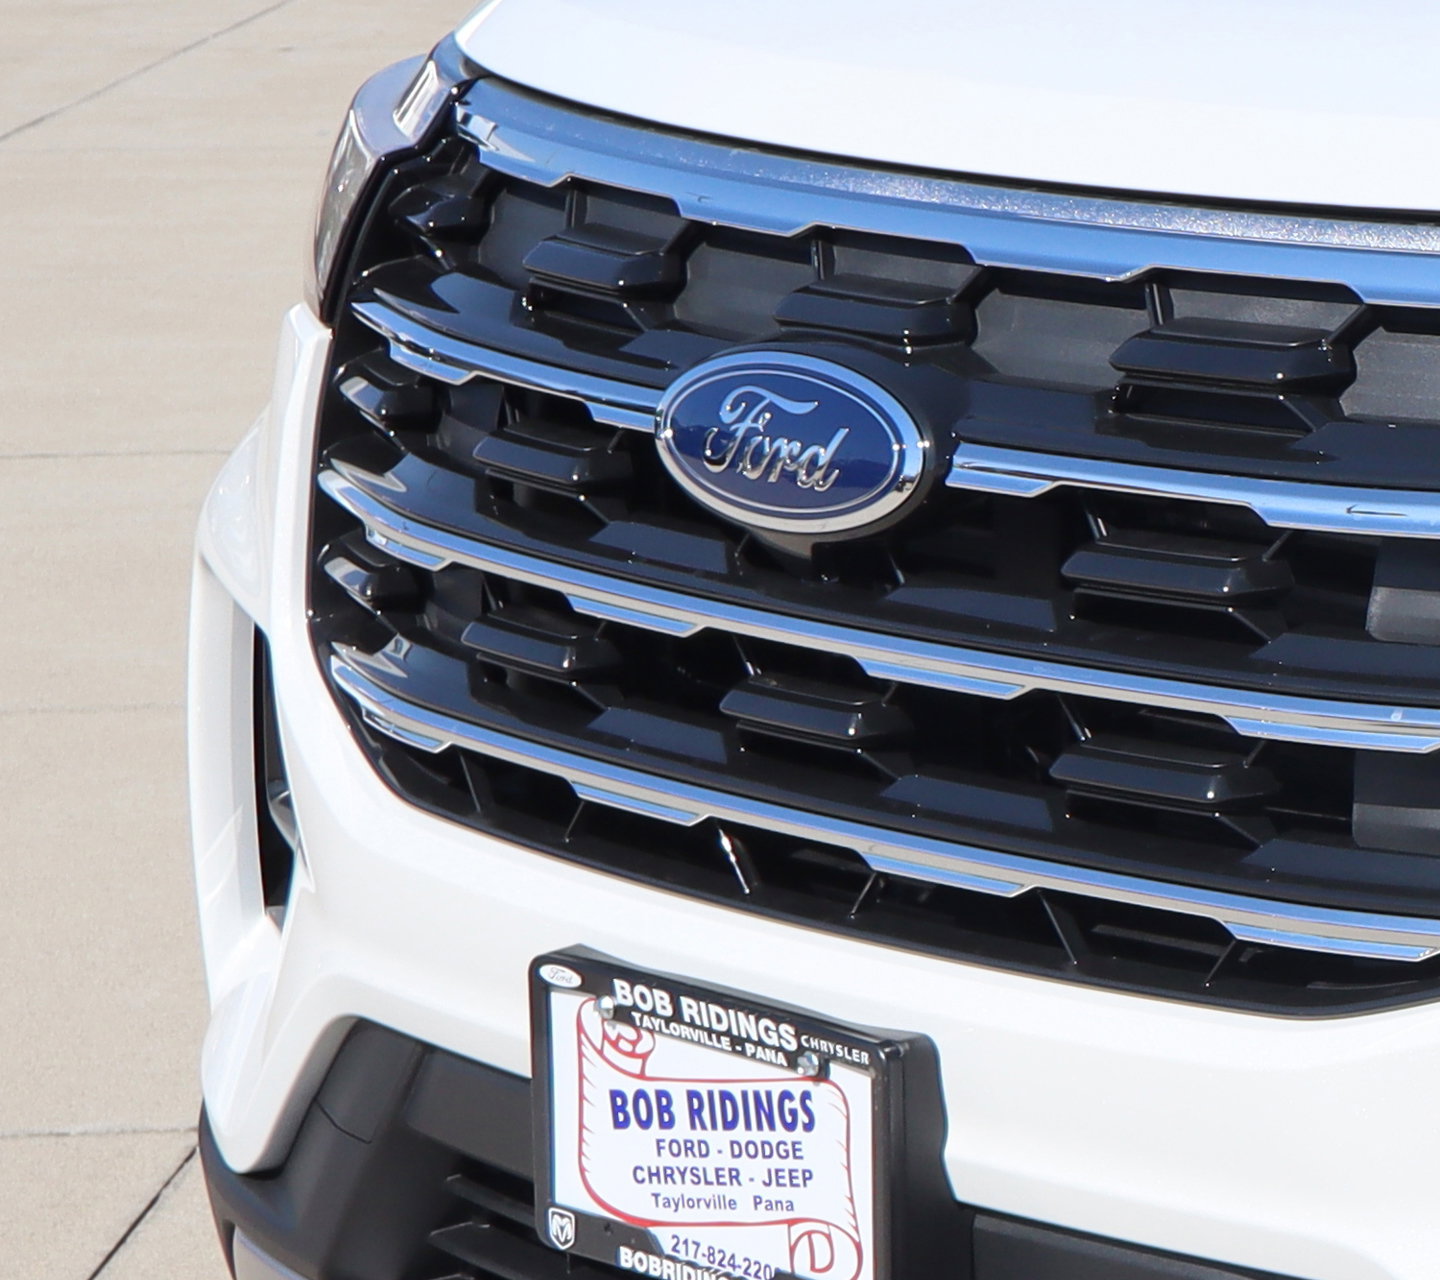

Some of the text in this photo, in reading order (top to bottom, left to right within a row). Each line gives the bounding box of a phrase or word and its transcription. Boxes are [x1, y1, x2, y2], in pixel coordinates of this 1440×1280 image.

[704, 386, 849, 491] Ford
[613, 978, 798, 1051] BOB RIDINGS
[632, 1012, 732, 1052] TAYLORVILLE
[746, 1043, 787, 1067] PANA
[801, 1035, 870, 1065] CHRYSLER
[609, 1089, 815, 1132] BOB RIDINGS
[655, 1138, 710, 1158] FORD
[729, 1140, 804, 1160] DODGE
[632, 1166, 742, 1187] CHRYSLER
[762, 1169, 813, 1188] JEEP
[651, 1193, 794, 1212] Taylorville Pana
